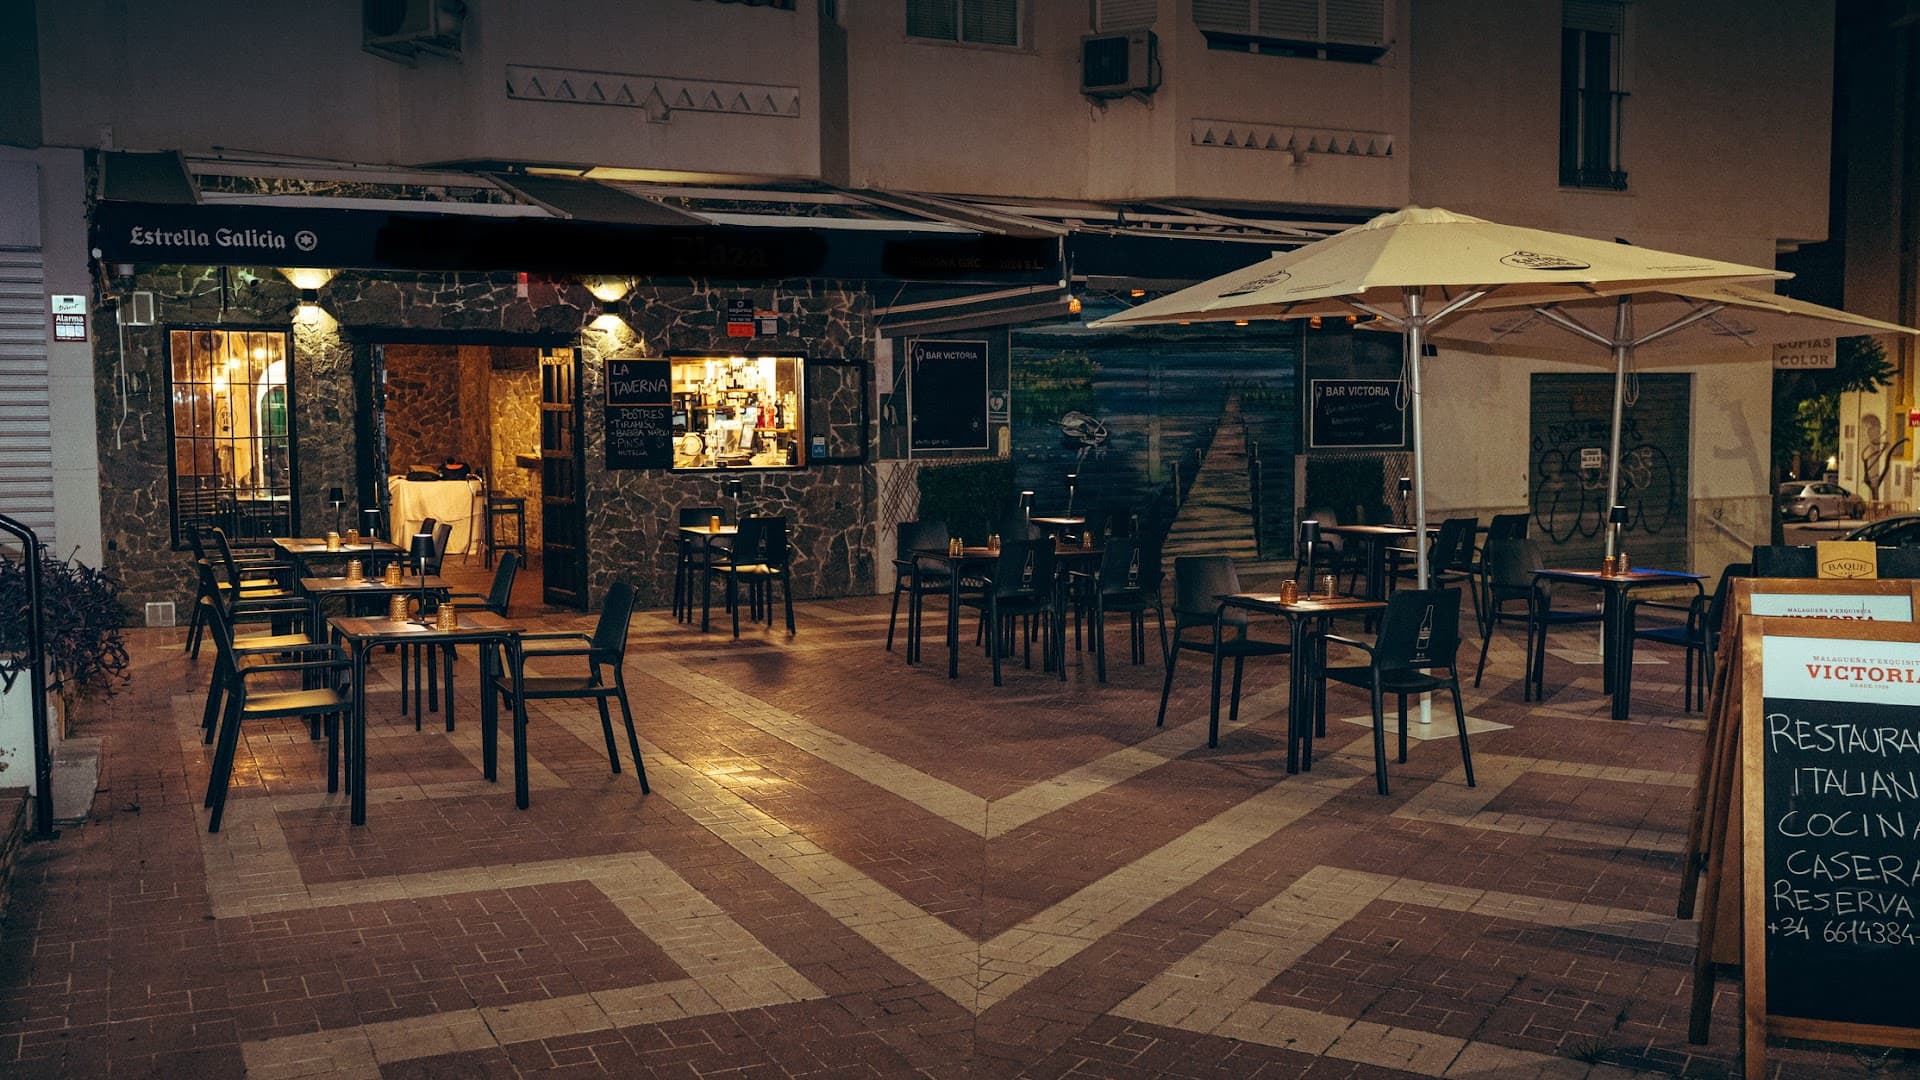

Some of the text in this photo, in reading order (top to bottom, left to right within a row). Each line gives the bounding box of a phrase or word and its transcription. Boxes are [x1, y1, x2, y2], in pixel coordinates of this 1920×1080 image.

[129, 226, 287, 249] Estrella Galicia
[926, 351, 978, 360] BAR VICTORIA
[1779, 354, 1829, 366] COLOR
[612, 364, 630, 376] LA
[611, 378, 668, 397] TAVERNA
[1325, 386, 1390, 397] BAR VICTORIA
[620, 407, 665, 420] POSTRES
[1827, 561, 1867, 572] BAQUE
[1812, 655, 1867, 664] MALAGUEÑA
[1805, 664, 1920, 683] VICTORI
[1766, 713, 1920, 757] RESTAURA
[1773, 879, 1915, 919] RESERVA
[1767, 917, 1810, 940] +34
